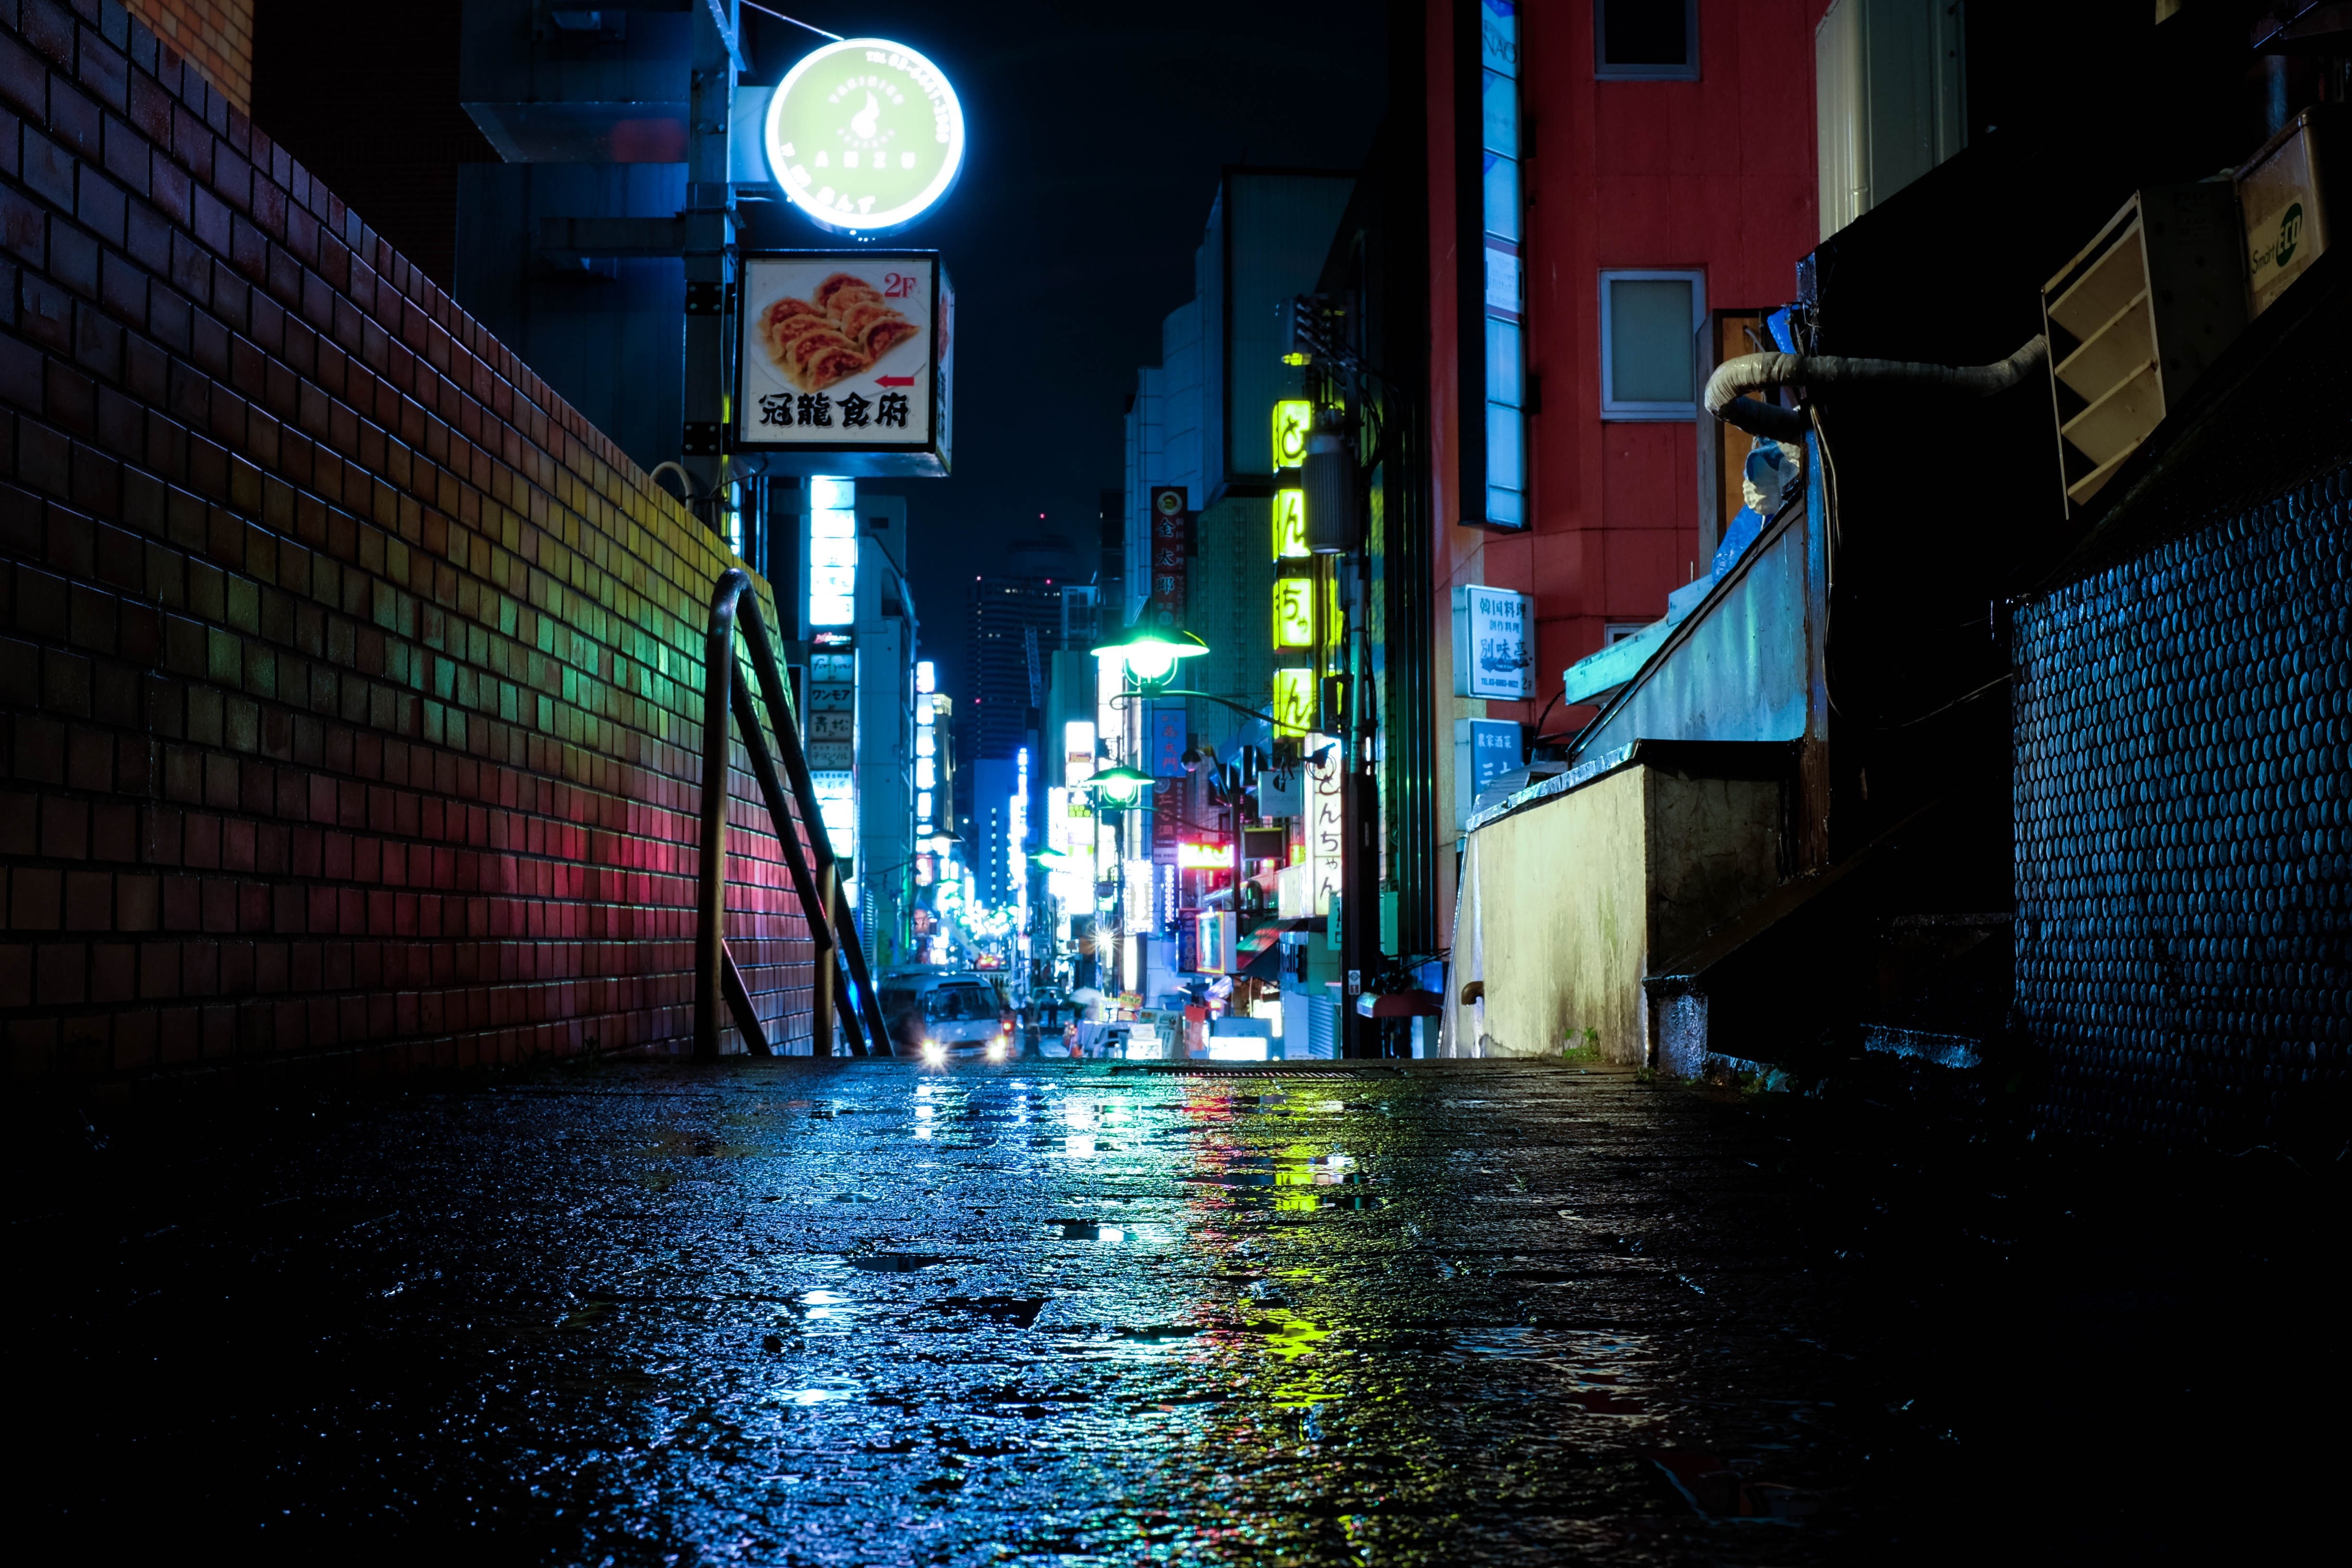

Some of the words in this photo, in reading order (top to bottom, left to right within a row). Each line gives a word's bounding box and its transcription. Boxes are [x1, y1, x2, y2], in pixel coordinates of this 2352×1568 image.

[2252, 242, 2275, 274] Smart
[884, 272, 915, 297] 2F
[759, 392, 909, 428] 冠龍食府
[1156, 517, 1176, 595] 金太郎
[1480, 597, 1526, 619] 韓国料理
[812, 690, 851, 700] ワンモア
